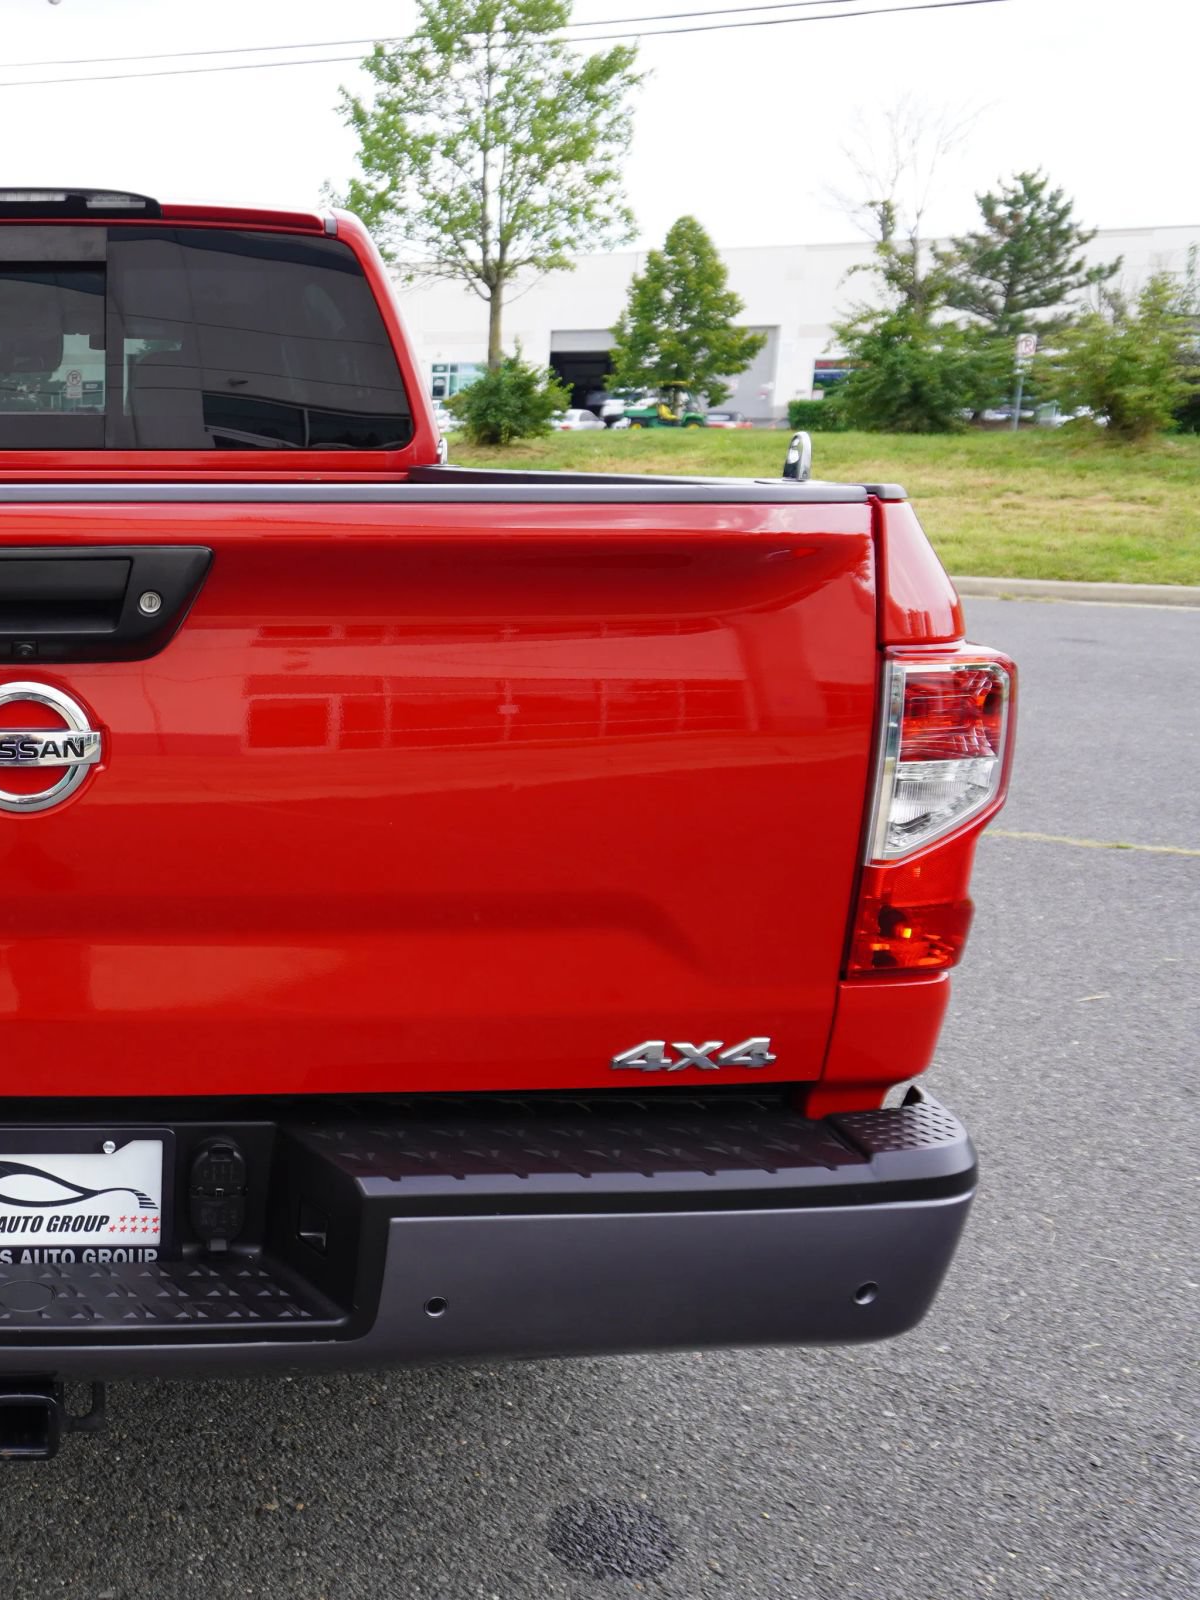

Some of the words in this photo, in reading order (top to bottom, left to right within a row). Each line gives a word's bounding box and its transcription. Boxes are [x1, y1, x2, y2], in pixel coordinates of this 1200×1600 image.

[46, 1214, 110, 1233] GROUP
[20, 1248, 76, 1264] AUTO
[81, 1248, 158, 1264] GROUP
